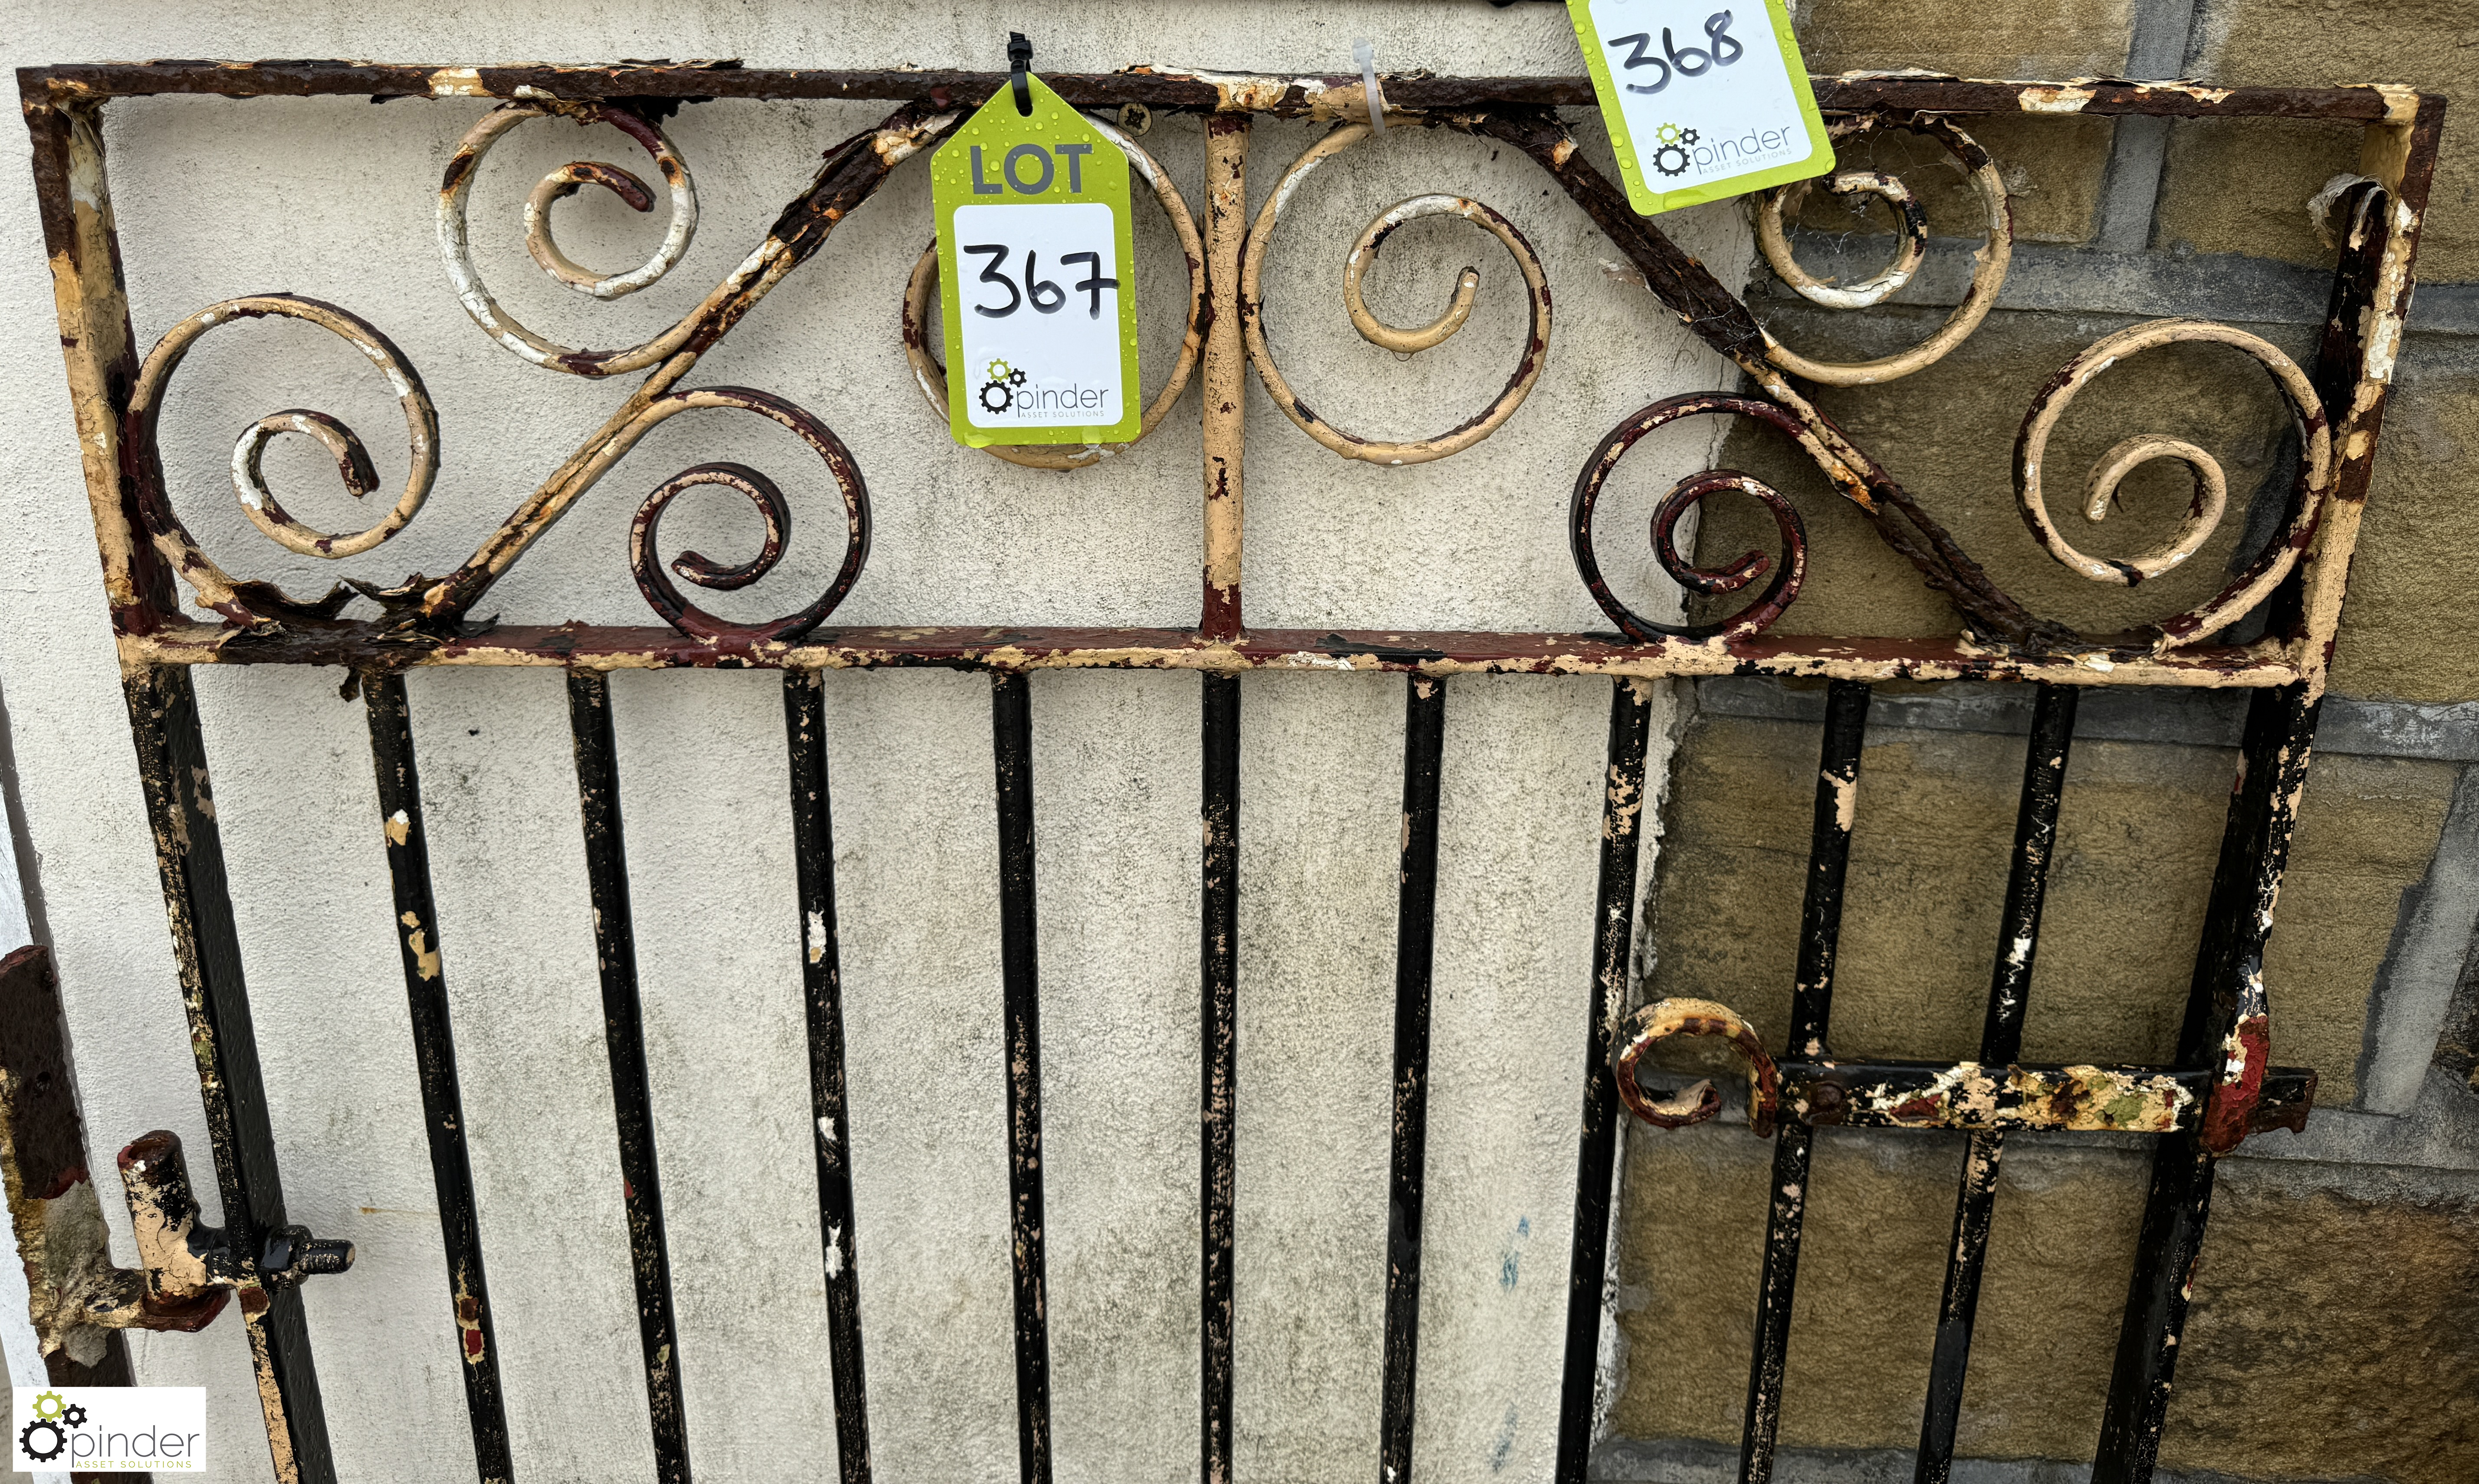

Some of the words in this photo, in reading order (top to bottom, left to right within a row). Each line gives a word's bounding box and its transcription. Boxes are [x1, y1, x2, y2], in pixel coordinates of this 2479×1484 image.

[1608, 9, 1743, 95] 368
[970, 144, 1093, 195] LOT
[1692, 126, 1791, 175] pinder
[1702, 163, 1732, 174] ASSET
[1736, 149, 1792, 167] SOLUTIONS
[963, 243, 1121, 320] 367
[1017, 384, 1109, 418] pinder
